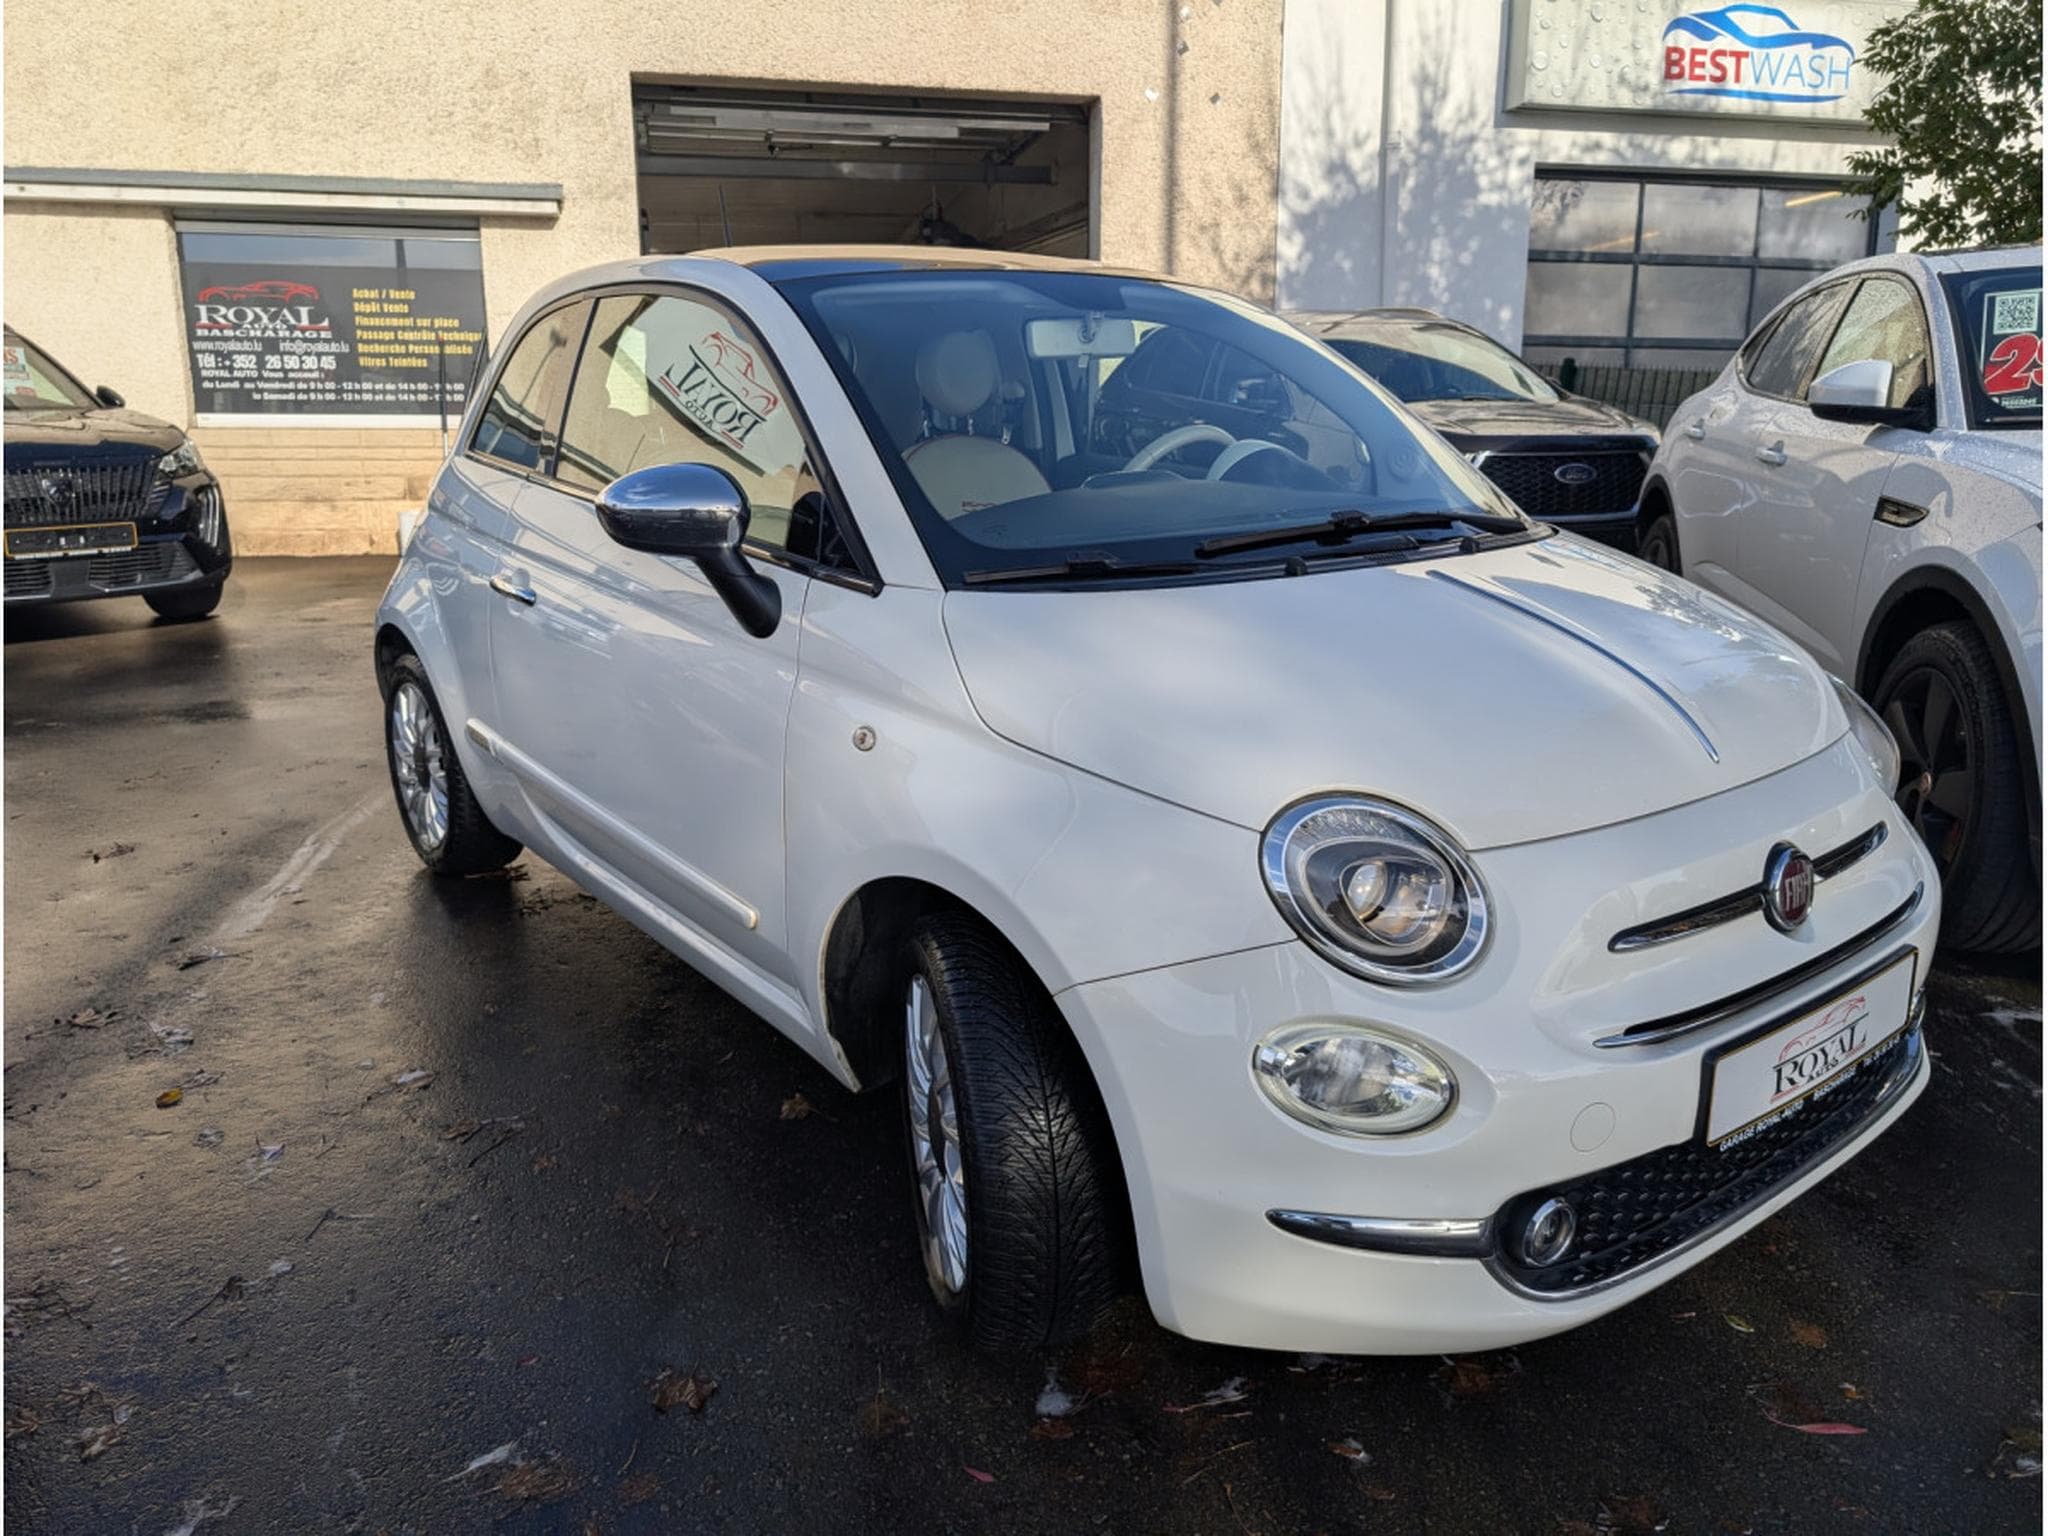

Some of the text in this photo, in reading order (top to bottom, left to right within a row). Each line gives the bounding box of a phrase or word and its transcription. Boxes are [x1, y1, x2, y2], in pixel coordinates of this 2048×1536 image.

[388, 289, 416, 300] Vente
[382, 303, 409, 314] Vente
[194, 304, 330, 326] ROYAL
[355, 316, 460, 328] Financement sur place
[195, 329, 333, 339] BASCHARAGE
[356, 329, 396, 341] Passage
[192, 339, 350, 355] www.royalauto.lu info@royalauto.lu
[357, 343, 473, 355] Recherche Personalisée
[232, 354, 258, 369] 352
[265, 355, 281, 369] 26
[283, 355, 300, 369] 50
[302, 356, 318, 370] 30
[320, 356, 337, 370] 45
[358, 356, 387, 367] Vitres
[1983, 332, 2043, 395] 2
[201, 370, 231, 378] ROYAL
[233, 370, 259, 378] AUTO
[215, 380, 240, 389] Lundi
[257, 380, 295, 390] Vendredi
[263, 391, 296, 401] Samedi
[1774, 1023, 1868, 1095] ROYAL
[1807, 1057, 1839, 1083] AUTO
[1720, 1124, 1755, 1151] GARAGE
